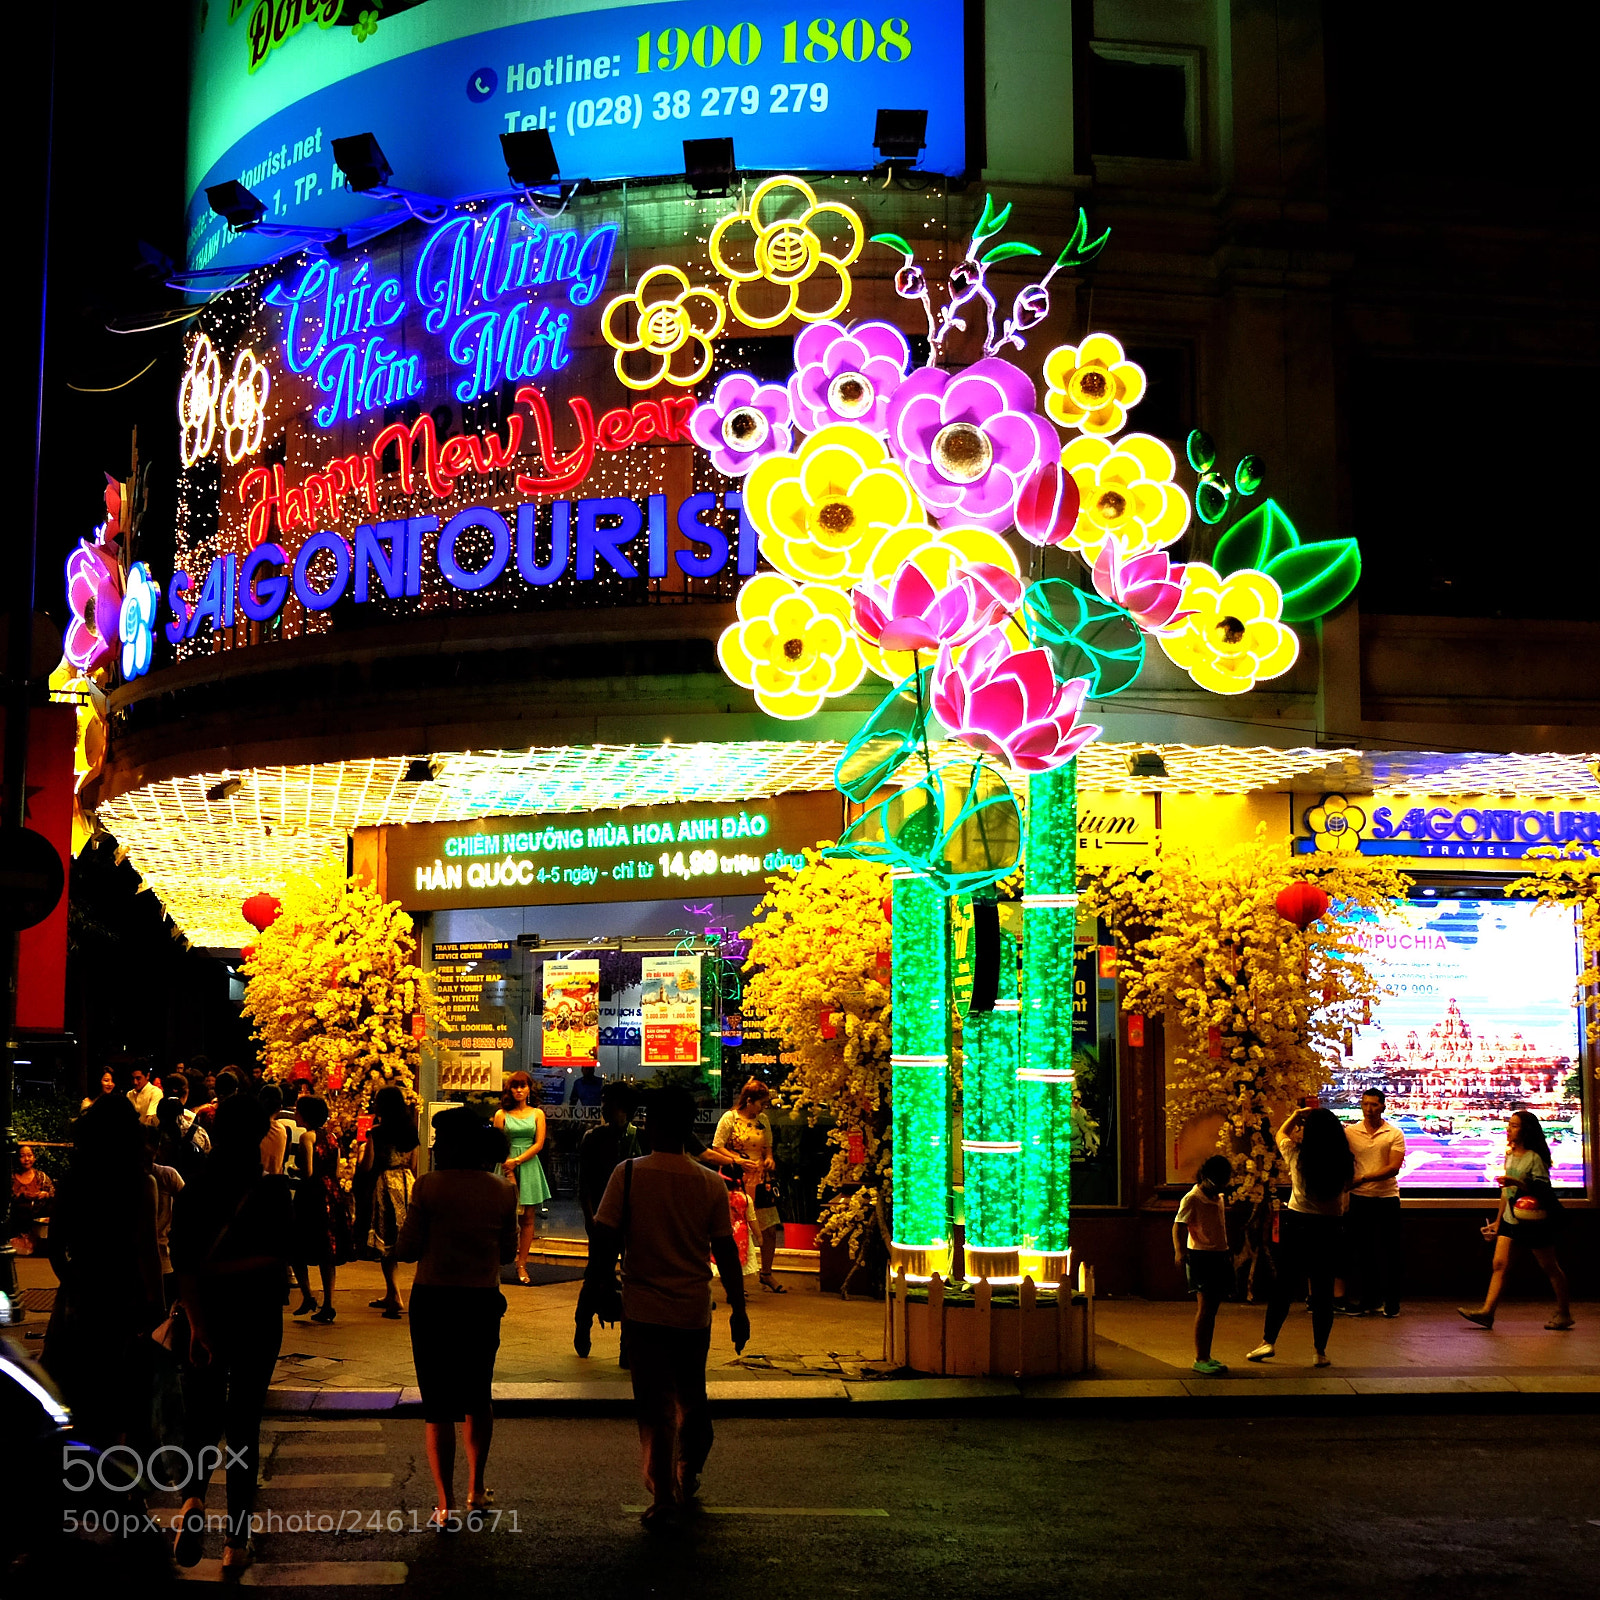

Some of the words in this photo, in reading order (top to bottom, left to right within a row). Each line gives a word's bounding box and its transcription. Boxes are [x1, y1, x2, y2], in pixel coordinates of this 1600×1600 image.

[506, 54, 621, 94] Hotline:
[635, 21, 763, 74] 1900
[780, 17, 912, 64] 1808
[504, 108, 557, 134] Tel:
[565, 93, 643, 137] (028)
[652, 88, 691, 122] 38
[700, 85, 760, 117] 279
[769, 82, 829, 114] 279
[238, 126, 323, 190] tourist.net
[294, 172, 323, 205] TP.
[240, 454, 378, 550] Happy
[372, 413, 524, 497] New
[165, 490, 759, 645] SAIGONTOURIST
[445, 832, 500, 857] CHIÊM
[587, 820, 630, 847] MÙA
[632, 822, 675, 845] HOA
[677, 818, 718, 842] ANH
[1078, 809, 1139, 834] ium
[1372, 806, 1600, 842] SAIGONTOURI
[1079, 838, 1103, 849] EL
[1426, 845, 1510, 856] TRAVEL
[415, 858, 462, 891] HÀN
[536, 865, 561, 884] 4-5
[460, 942, 503, 951] INFORMATION
[1345, 934, 1447, 950] AMPUCHIA
[437, 985, 458, 993] DAILY
[455, 974, 485, 982] TOURIST
